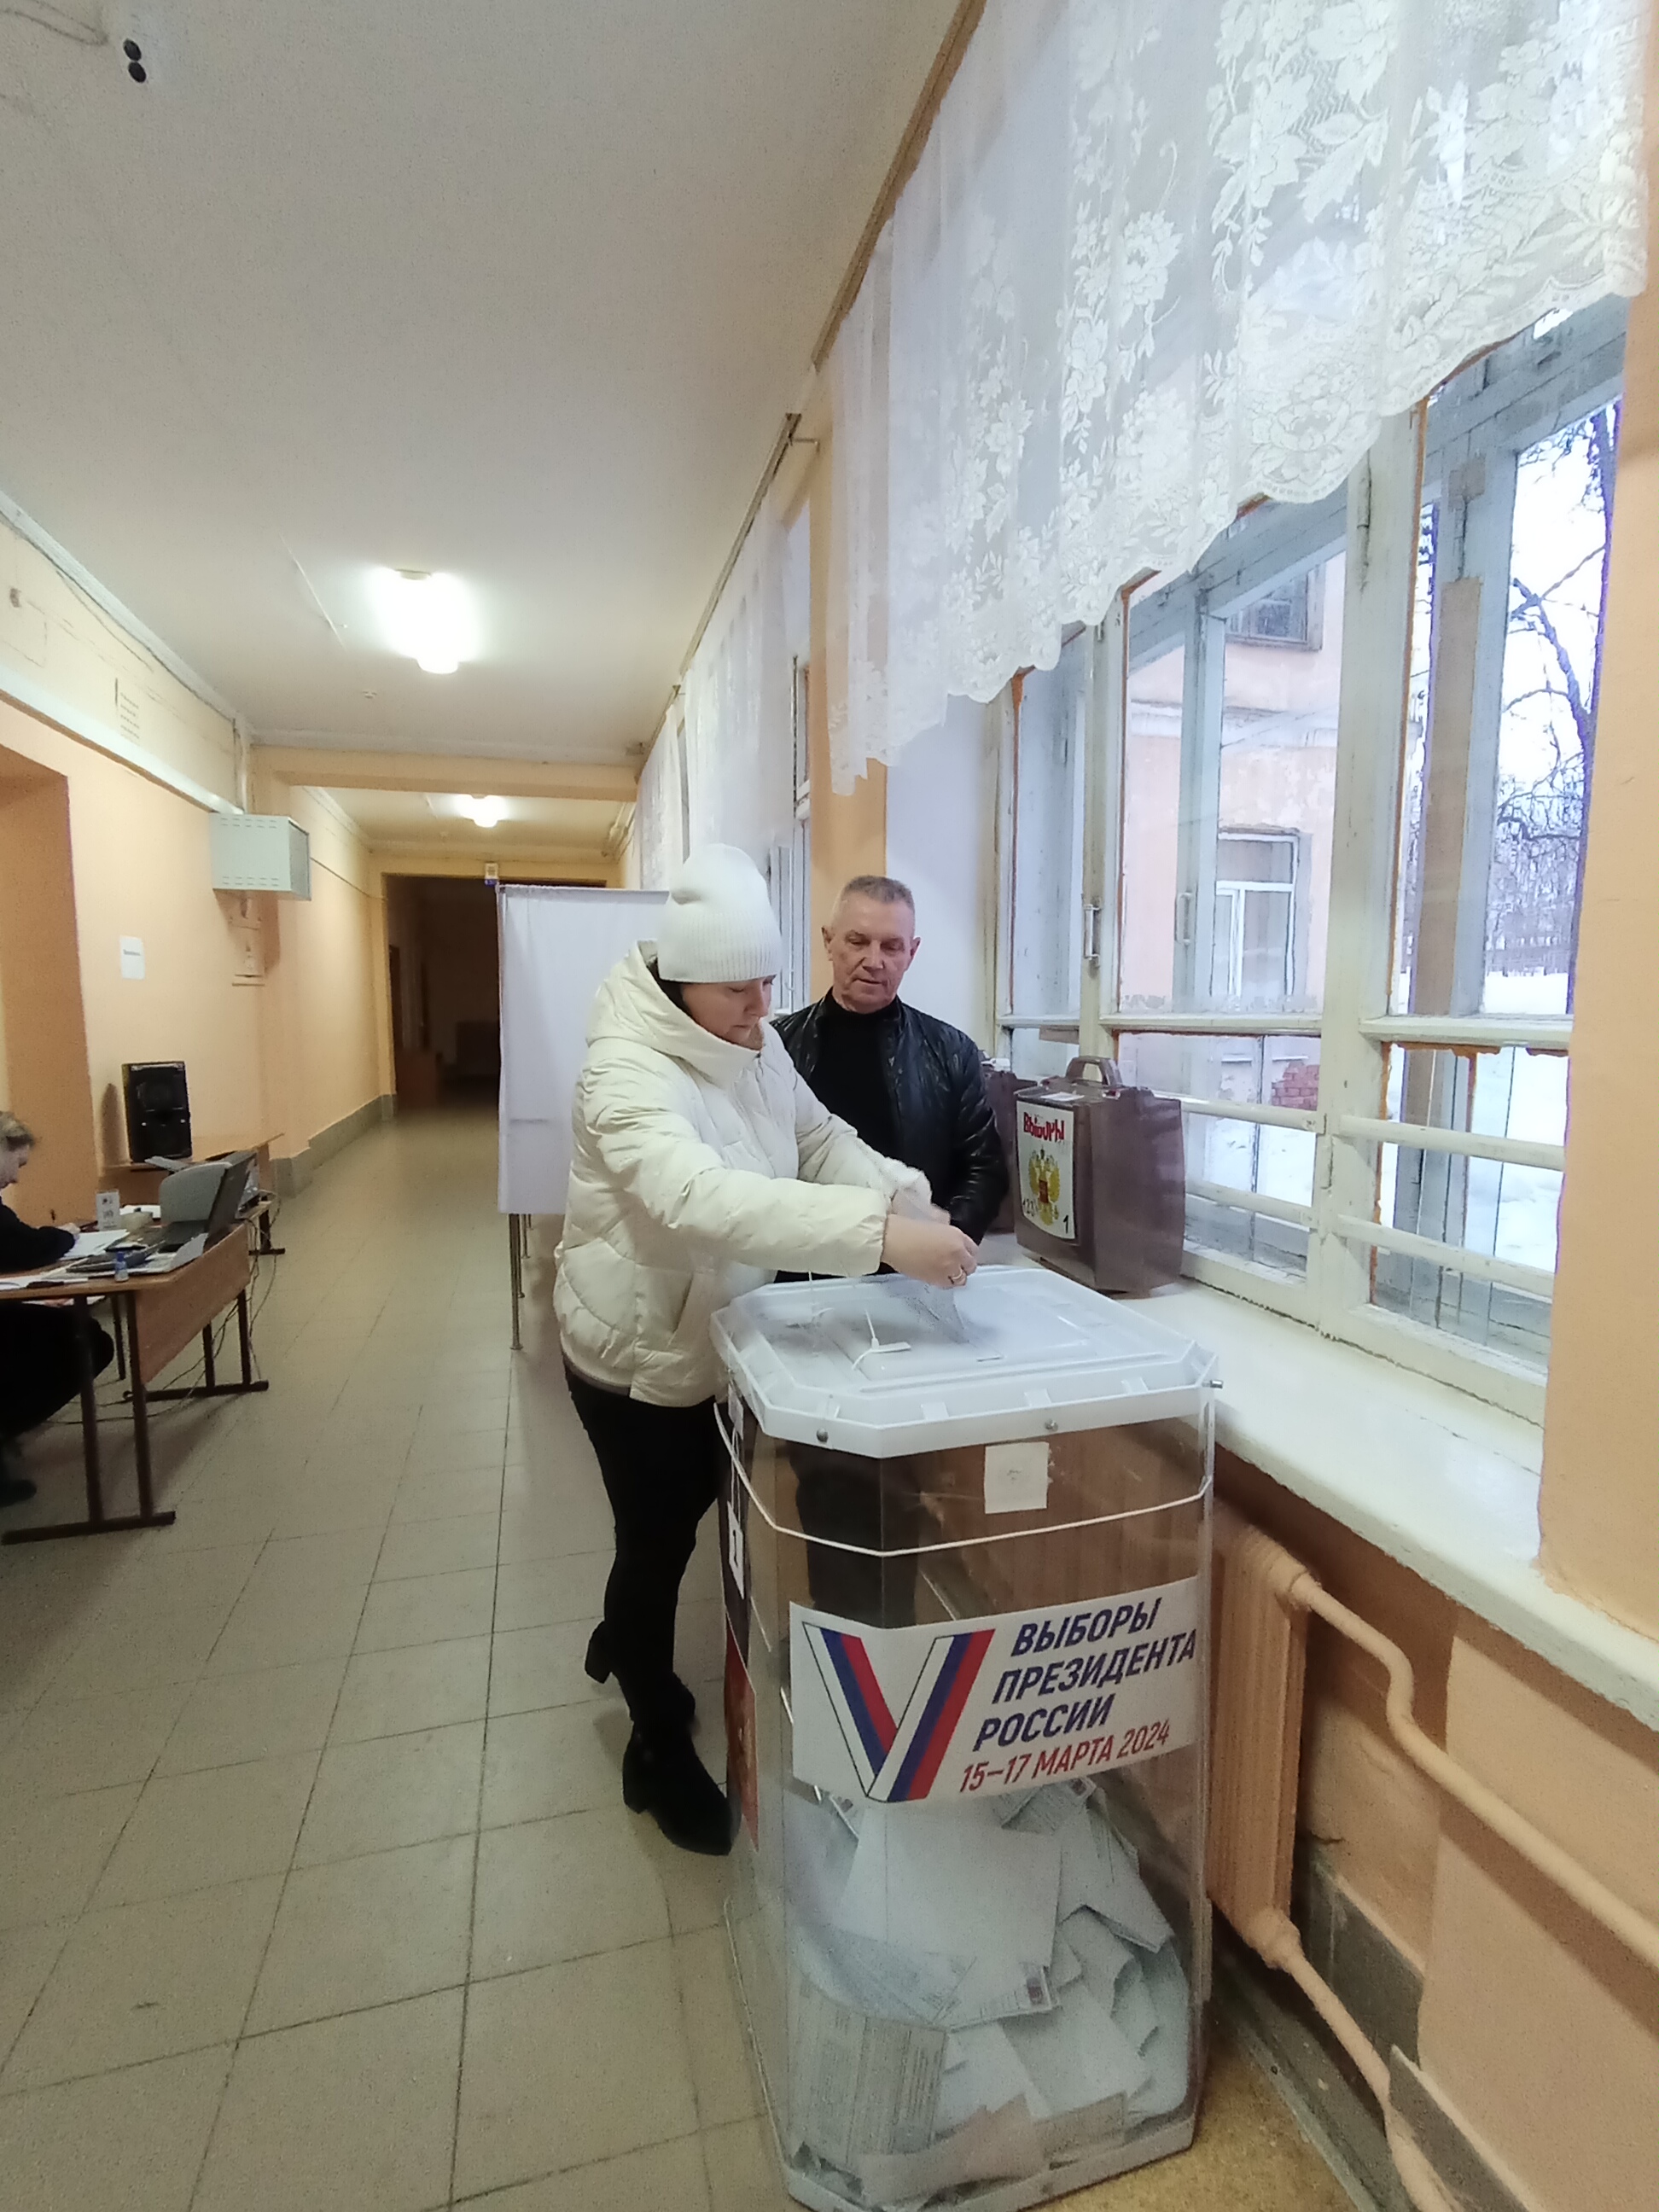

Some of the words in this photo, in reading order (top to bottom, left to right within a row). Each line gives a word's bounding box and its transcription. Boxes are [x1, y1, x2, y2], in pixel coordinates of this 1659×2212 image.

[1010, 1597, 1163, 1657] ВЫБОРЫ
[991, 1628, 1197, 1705] ПРЕЗИДЕНТА
[972, 1692, 1117, 1752] РОССИИ
[1031, 1733, 1115, 1780] МАРТА
[1115, 1718, 1171, 1761] 2024
